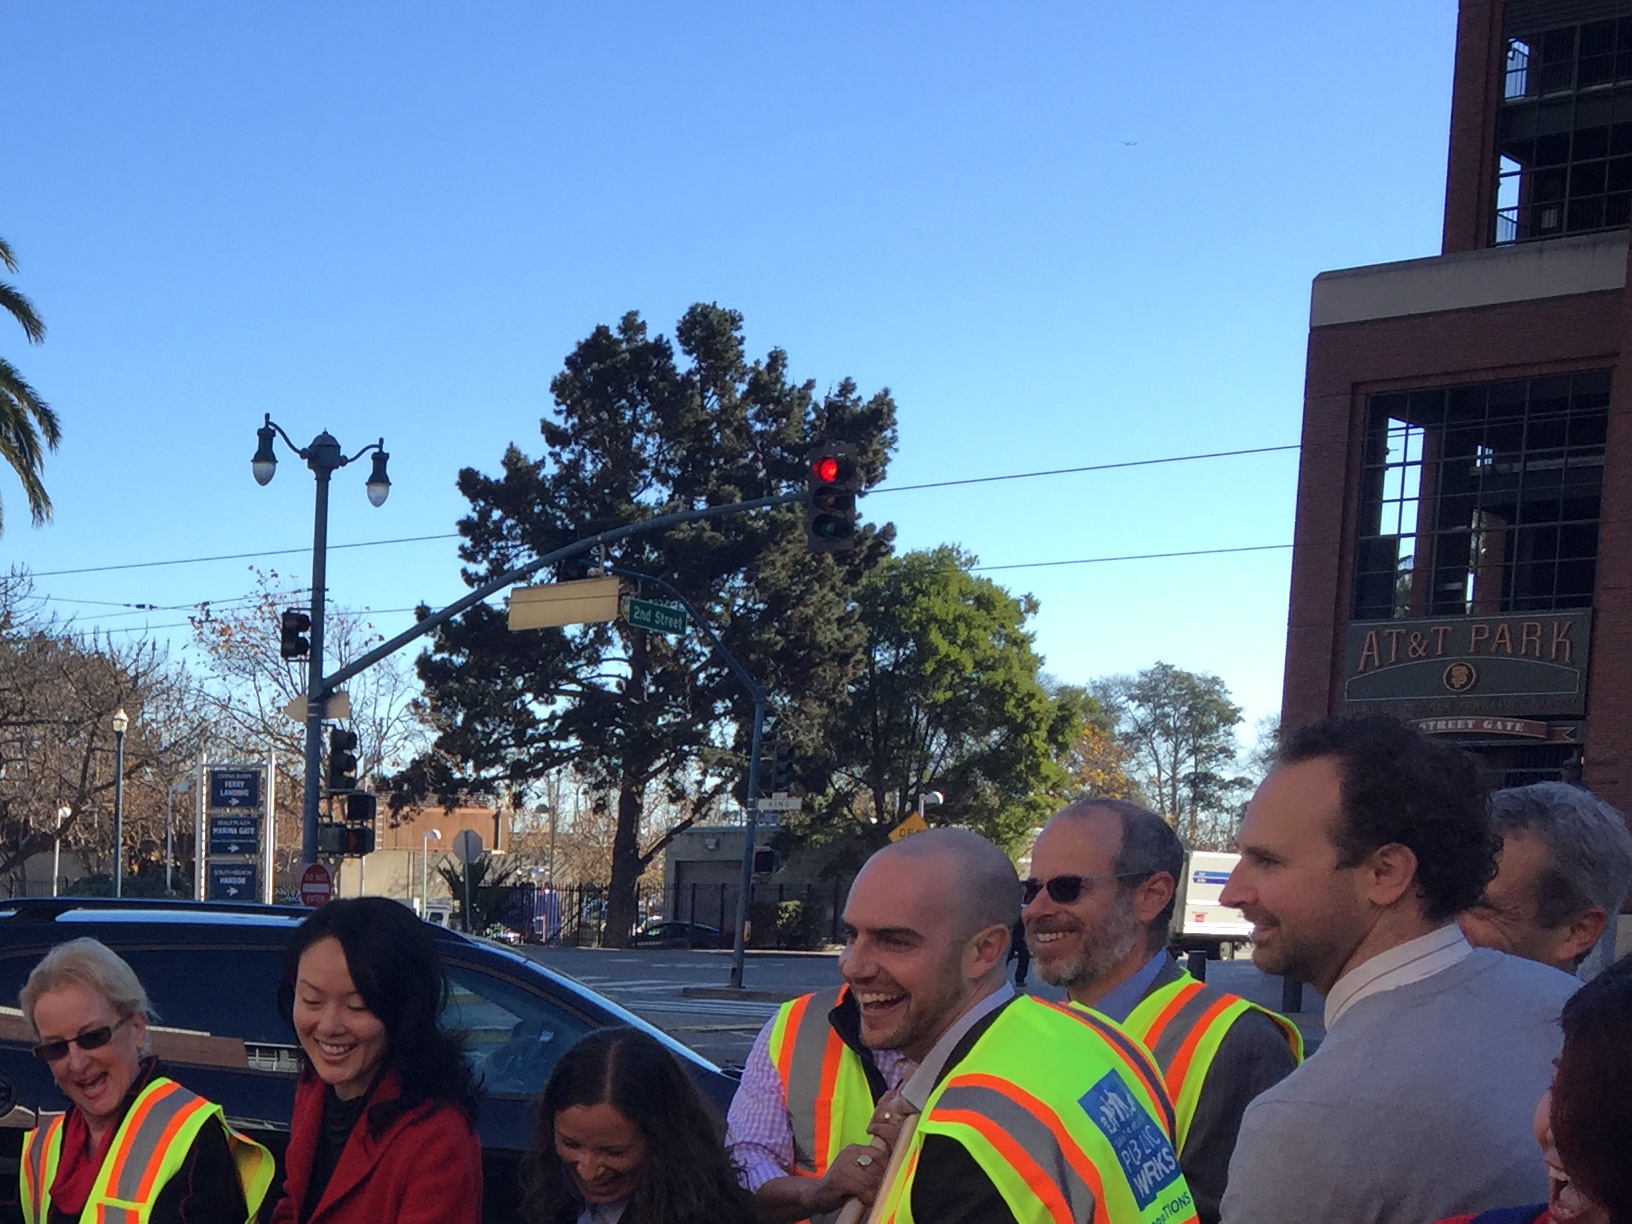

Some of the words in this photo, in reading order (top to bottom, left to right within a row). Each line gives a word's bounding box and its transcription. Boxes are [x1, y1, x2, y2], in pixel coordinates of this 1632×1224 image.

[633, 606, 651, 623] 2nd
[654, 612, 683, 630] Street
[1358, 626, 1452, 672] AT&T
[1470, 620, 1574, 663] PARK
[1482, 720, 1525, 732] GATE
[1133, 1148, 1176, 1198] WRKS
